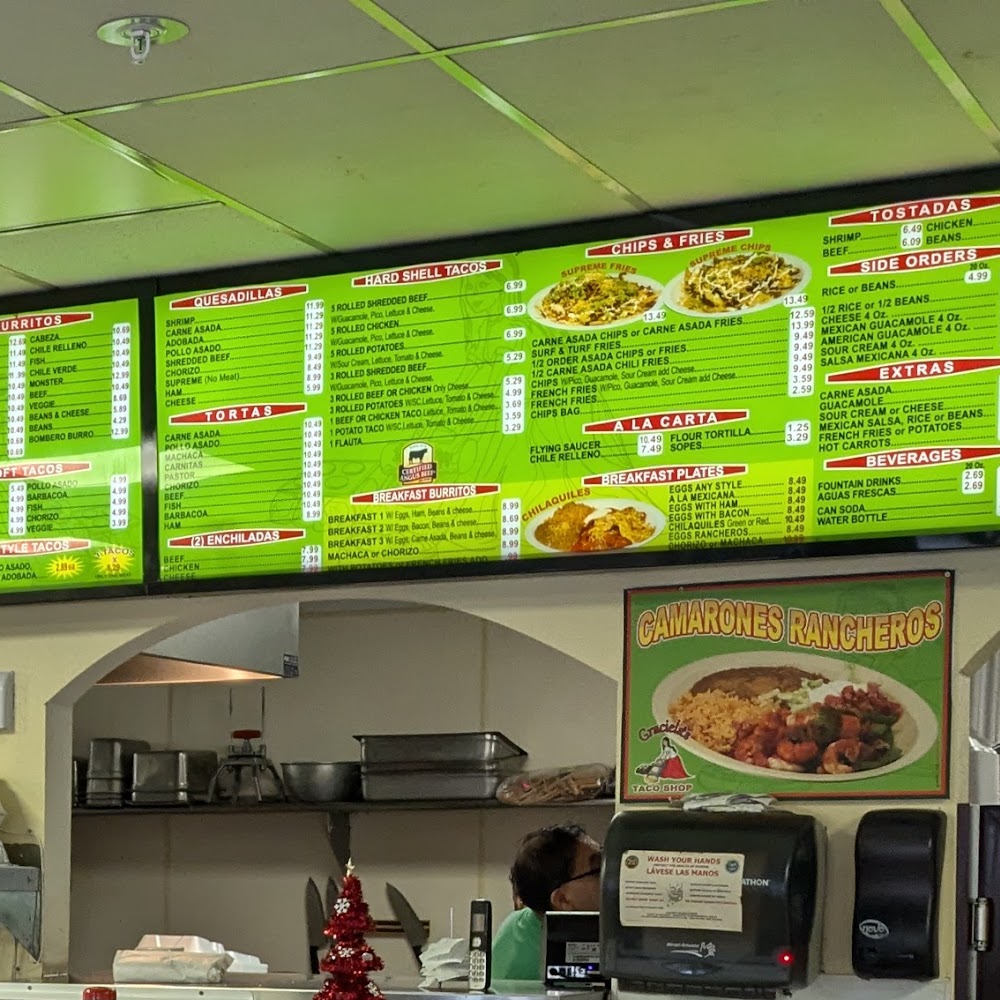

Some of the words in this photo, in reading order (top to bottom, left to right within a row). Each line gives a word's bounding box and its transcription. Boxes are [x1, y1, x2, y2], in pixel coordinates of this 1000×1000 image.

[870, 199, 970, 221] TOSTADAS
[926, 219, 972, 232] CHICKEN
[823, 233, 861, 244] SHRIMP
[903, 225, 921, 233] 6.49
[926, 233, 961, 244] BEANS
[612, 239, 660, 254] CHIPS
[664, 238, 672, 249] &
[680, 231, 725, 246] FRIES
[690, 244, 737, 266] SUPREME
[740, 243, 771, 251] CHIPS
[823, 247, 848, 257] BEEF
[861, 258, 899, 272] SIDE
[906, 250, 977, 267] ORDERS
[366, 273, 399, 284] HARD
[402, 269, 441, 281] SHELL
[444, 262, 486, 276] TACOS
[560, 263, 606, 278] SUPREME
[610, 263, 638, 274] FRIES
[968, 272, 988, 280] 4.99
[506, 281, 523, 290] 6.99
[822, 286, 845, 296] RICE
[861, 281, 895, 292] BEANS
[194, 288, 282, 307] QUESADILLAS
[784, 296, 808, 305] 13.49
[166, 317, 194, 327] SHRIMP
[642, 312, 666, 321] 13.49
[166, 327, 192, 337] CARNE
[194, 324, 221, 333] ASADA
[30, 334, 59, 343] CABEZA
[821, 355, 853, 366] SALSA
[856, 350, 908, 362] MEXICANA
[166, 367, 200, 377] CHORIZO
[880, 362, 954, 379] EXTRAS
[29, 379, 63, 387] MONSTER
[166, 377, 202, 387] SUPREME
[166, 389, 182, 397] HAM
[166, 398, 195, 407] CHEESE
[530, 410, 557, 419] CHIPS
[561, 408, 580, 416] BAG
[793, 386, 812, 394] 2.59
[820, 398, 883, 410] GUACAMOLE
[205, 406, 272, 422] TORTAS
[614, 420, 624, 430] A
[632, 418, 652, 430] LA
[660, 412, 718, 426] CARTA
[29, 433, 66, 443] BOMBERO
[68, 430, 94, 439] BURRO
[670, 432, 701, 442] FLOUR
[704, 428, 750, 439] TORTILLA
[788, 424, 809, 432] 1.25
[819, 442, 838, 452] HOT
[842, 439, 891, 450] CARROTS
[866, 449, 961, 467] BEVERAGES
[22, 465, 63, 476] TACOS
[601, 471, 674, 486] BREAKFAST
[676, 467, 724, 480] PLATES
[818, 479, 863, 490] FOUNTAIN
[866, 477, 901, 487] DRINKS
[373, 489, 427, 502] BREAKFAST
[429, 486, 476, 498] BURRITOS
[818, 491, 849, 501] AGUAS
[853, 488, 896, 498] FRESCAS
[522, 488, 590, 521] CHILAQUILES
[818, 507, 836, 515] CAN
[840, 504, 865, 513] SODA
[818, 515, 848, 525] WATER
[852, 513, 887, 523] BOTTLE
[191, 537, 204, 547] (2)
[207, 531, 279, 545] ENCHILADAS
[31, 542, 69, 552] TACOS
[637, 599, 784, 648] CAMARONES
[788, 600, 942, 651] RANCHEROS
